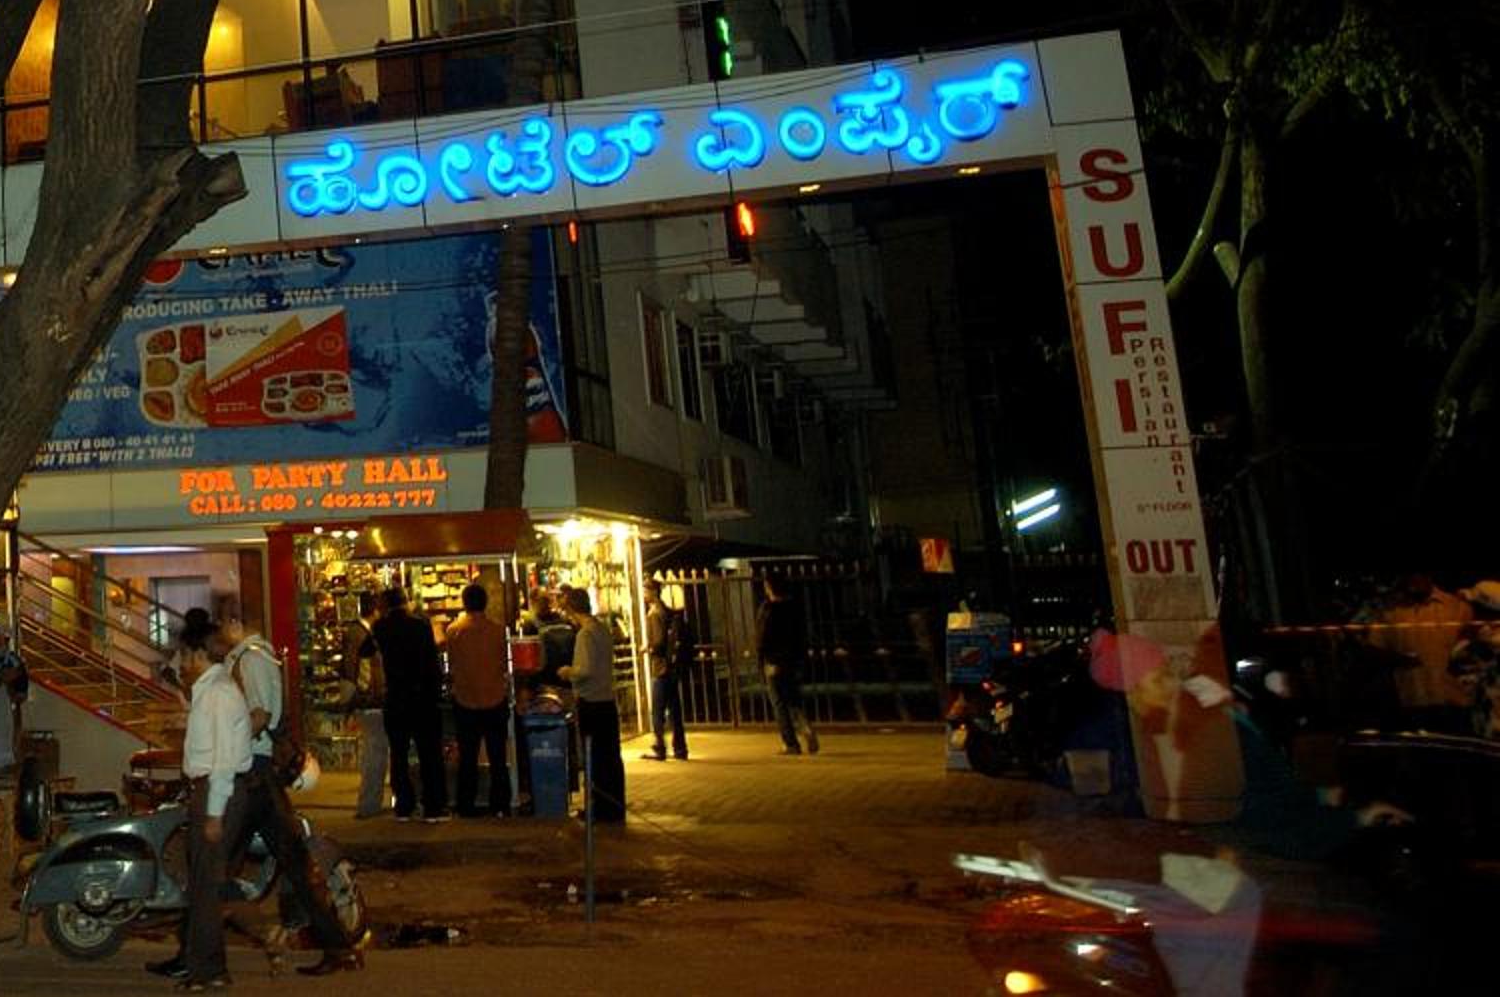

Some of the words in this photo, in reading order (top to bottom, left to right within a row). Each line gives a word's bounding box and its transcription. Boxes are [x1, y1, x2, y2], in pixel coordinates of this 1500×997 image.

[220, 292, 267, 312] TAKE
[282, 287, 336, 306] AWAY
[1080, 148, 1147, 433] SUFI
[41, 438, 80, 453] IVERY
[180, 469, 235, 493] FOR
[253, 463, 347, 490] PARTY
[363, 457, 446, 484] HALL
[1126, 539, 1197, 574] OUT
